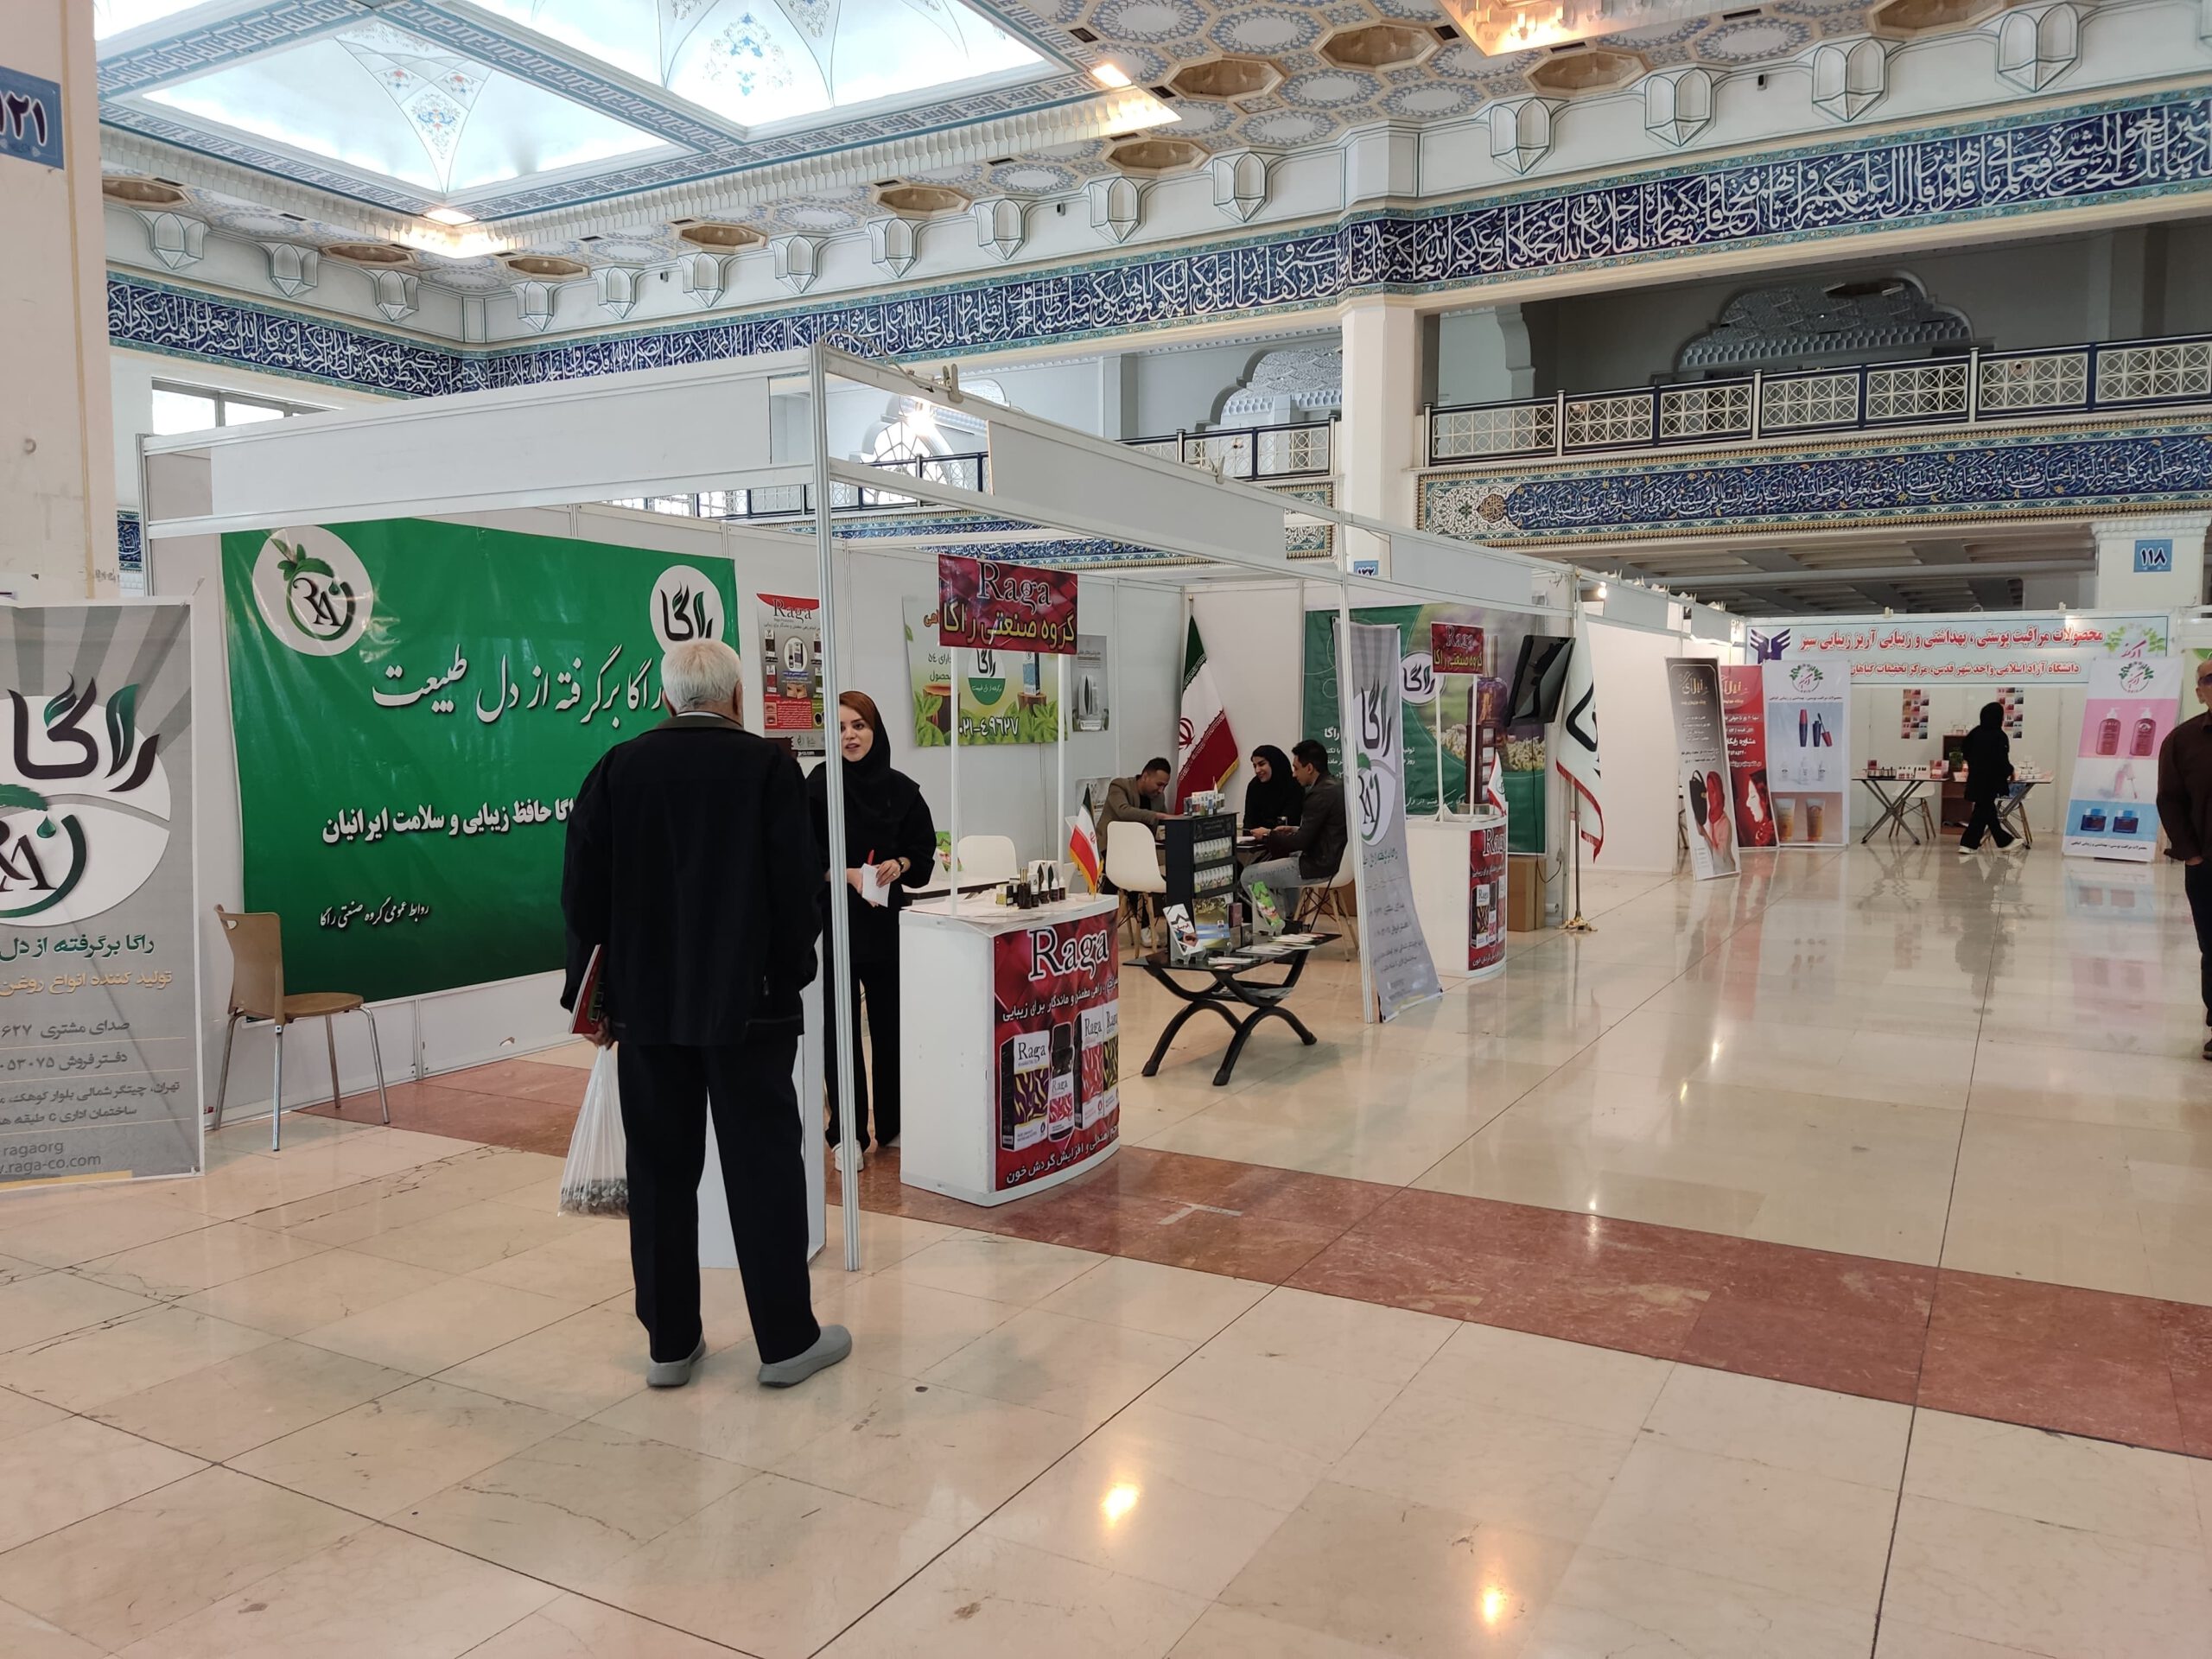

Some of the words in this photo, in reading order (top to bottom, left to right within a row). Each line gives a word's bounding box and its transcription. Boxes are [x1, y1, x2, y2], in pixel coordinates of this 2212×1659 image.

[2140, 547, 2167, 566] ۱۱۸
[977, 562, 1051, 614] Raga
[773, 599, 812, 624] Raga
[980, 615, 1036, 645] صنعتی
[1040, 607, 1075, 651] گروه
[1820, 628, 1852, 651] زیبایی
[1854, 627, 1877, 651] آریز
[1879, 627, 1913, 650] زیبایی
[1923, 627, 1967, 649] بهداشتی
[2012, 625, 2050, 648] مراقبت
[2052, 625, 2105, 647] محصولات
[1916, 635, 1921, 648] و
[372, 644, 467, 714] طبیعت
[1996, 662, 2025, 677] اسلامی
[2027, 662, 2047, 677] آزاد
[476, 654, 518, 723] دل
[526, 665, 550, 709] از
[391, 804, 446, 834] سلامت
[461, 805, 510, 836] زیبایی
[512, 799, 552, 825] حافظ
[321, 807, 389, 845] ایرانیان
[448, 814, 459, 836] و
[0, 937, 29, 961] دل
[32, 937, 48, 957] از
[54, 935, 120, 958] برگرفته
[126, 935, 155, 954] راگا
[1027, 927, 1109, 981] Raga
[49, 973, 86, 994] انواع
[91, 971, 131, 986] کننده
[136, 970, 173, 989] تولید
[1002, 1002, 1027, 1021] زیبایی
[1030, 1000, 1045, 1016] برای
[40, 1022, 86, 1039] مشتری
[90, 1020, 130, 1034] صدای
[1084, 1018, 1102, 1036] Raga
[59, 1052, 94, 1071] فروش
[1019, 1042, 1046, 1061] Raga
[50, 1090, 74, 1103] بلوار
[76, 1086, 112, 1103] شمالی
[14, 1113, 44, 1126] طبقه
[60, 1109, 86, 1123] اداری
[92, 1105, 137, 1120] ساختمان
[3, 1140, 64, 1159] ragaorg
[1057, 1142, 1084, 1166] افزایش
[1007, 1166, 1027, 1184] خون
[1028, 1154, 1055, 1176] گردش
